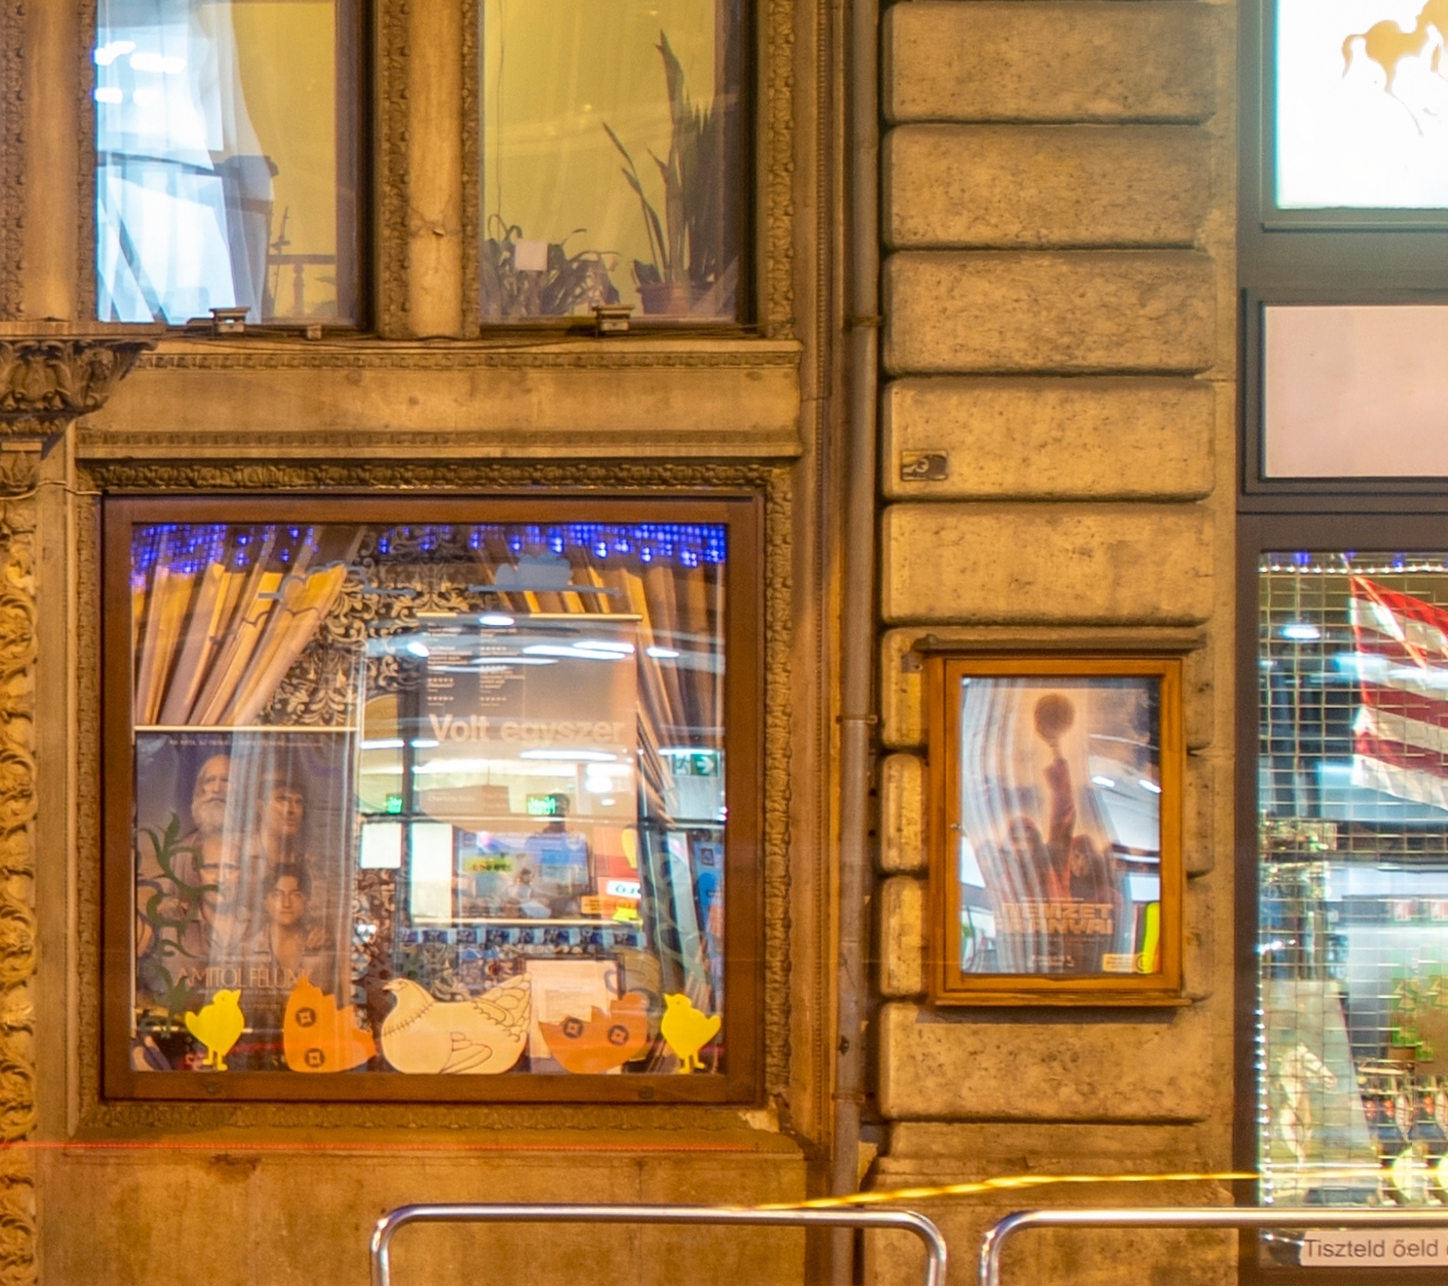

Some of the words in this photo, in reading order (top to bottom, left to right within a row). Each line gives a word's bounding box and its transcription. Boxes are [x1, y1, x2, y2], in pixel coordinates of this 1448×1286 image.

[428, 713, 490, 742] Volt
[500, 721, 625, 746] egyszer
[1304, 1239, 1386, 1258] Tiszteld
